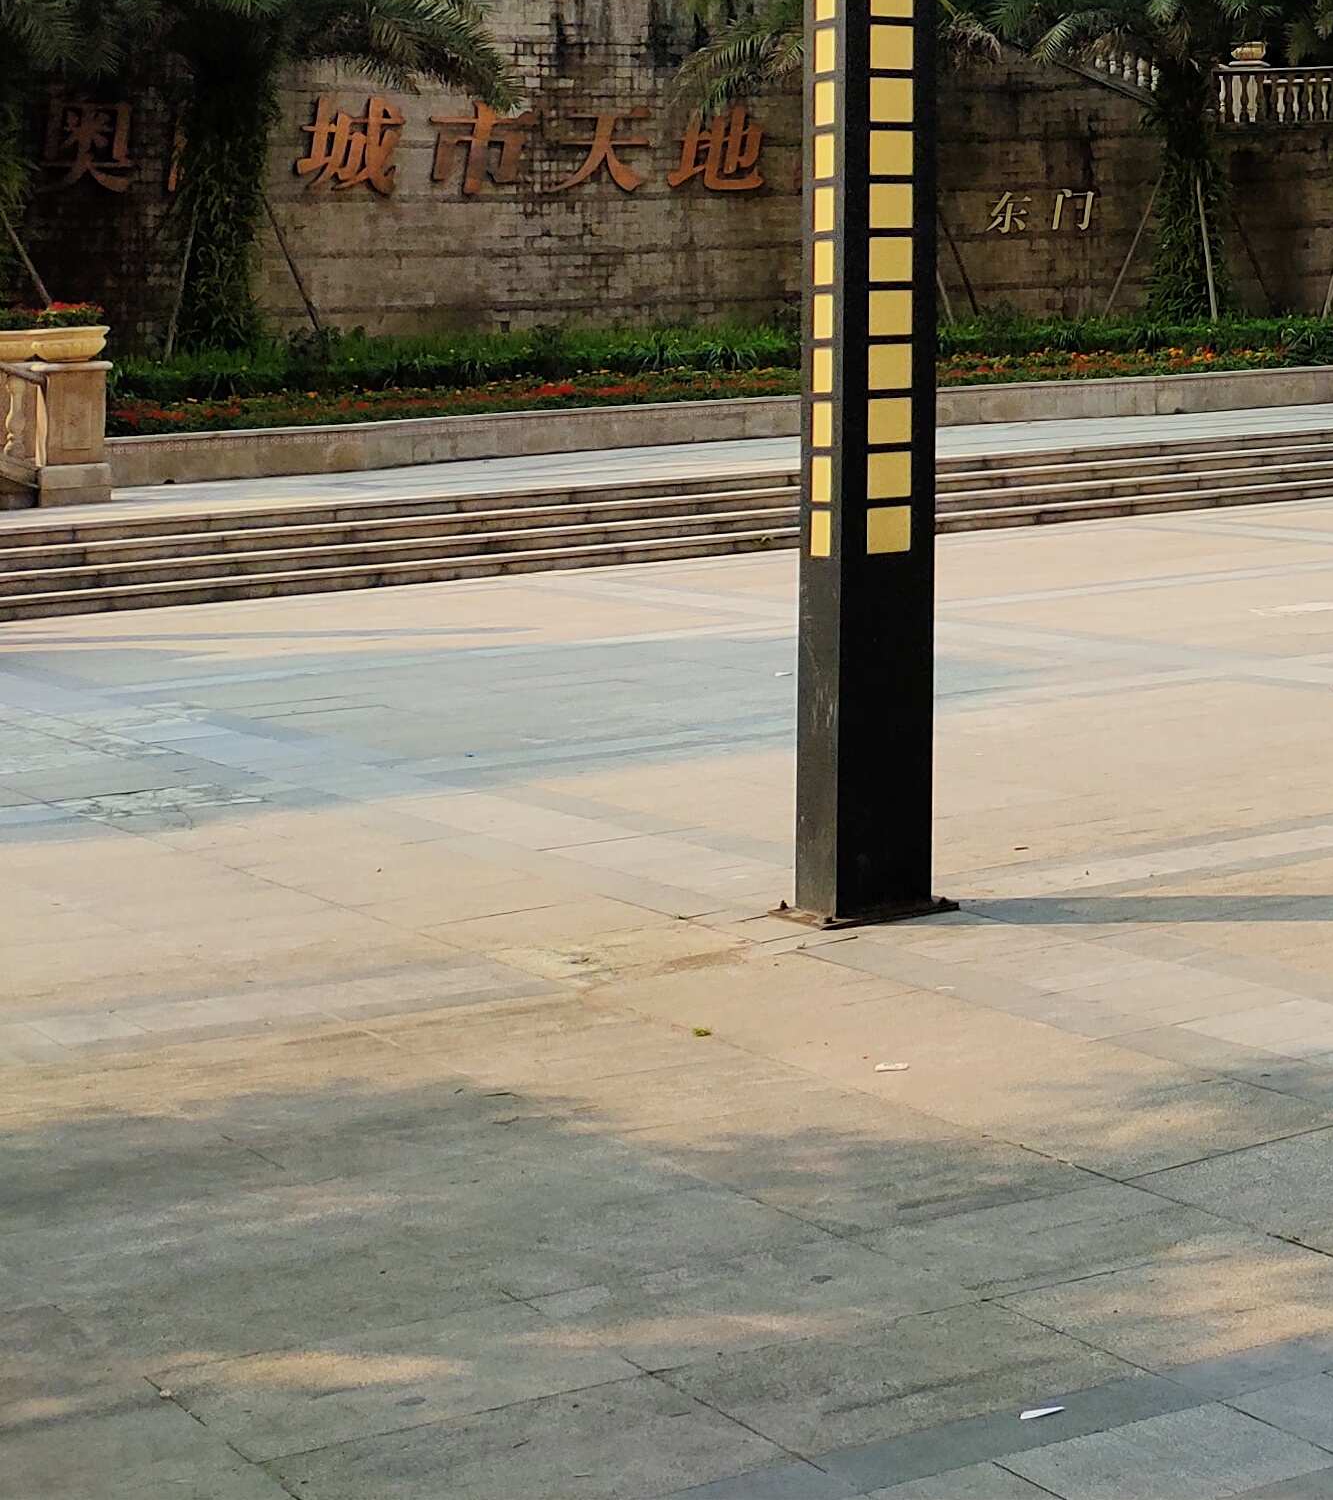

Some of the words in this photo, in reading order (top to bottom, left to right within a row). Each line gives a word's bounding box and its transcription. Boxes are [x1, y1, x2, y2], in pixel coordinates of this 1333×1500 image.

[35, 86, 764, 195] 奥城市天地
[985, 188, 1095, 234] 东门
